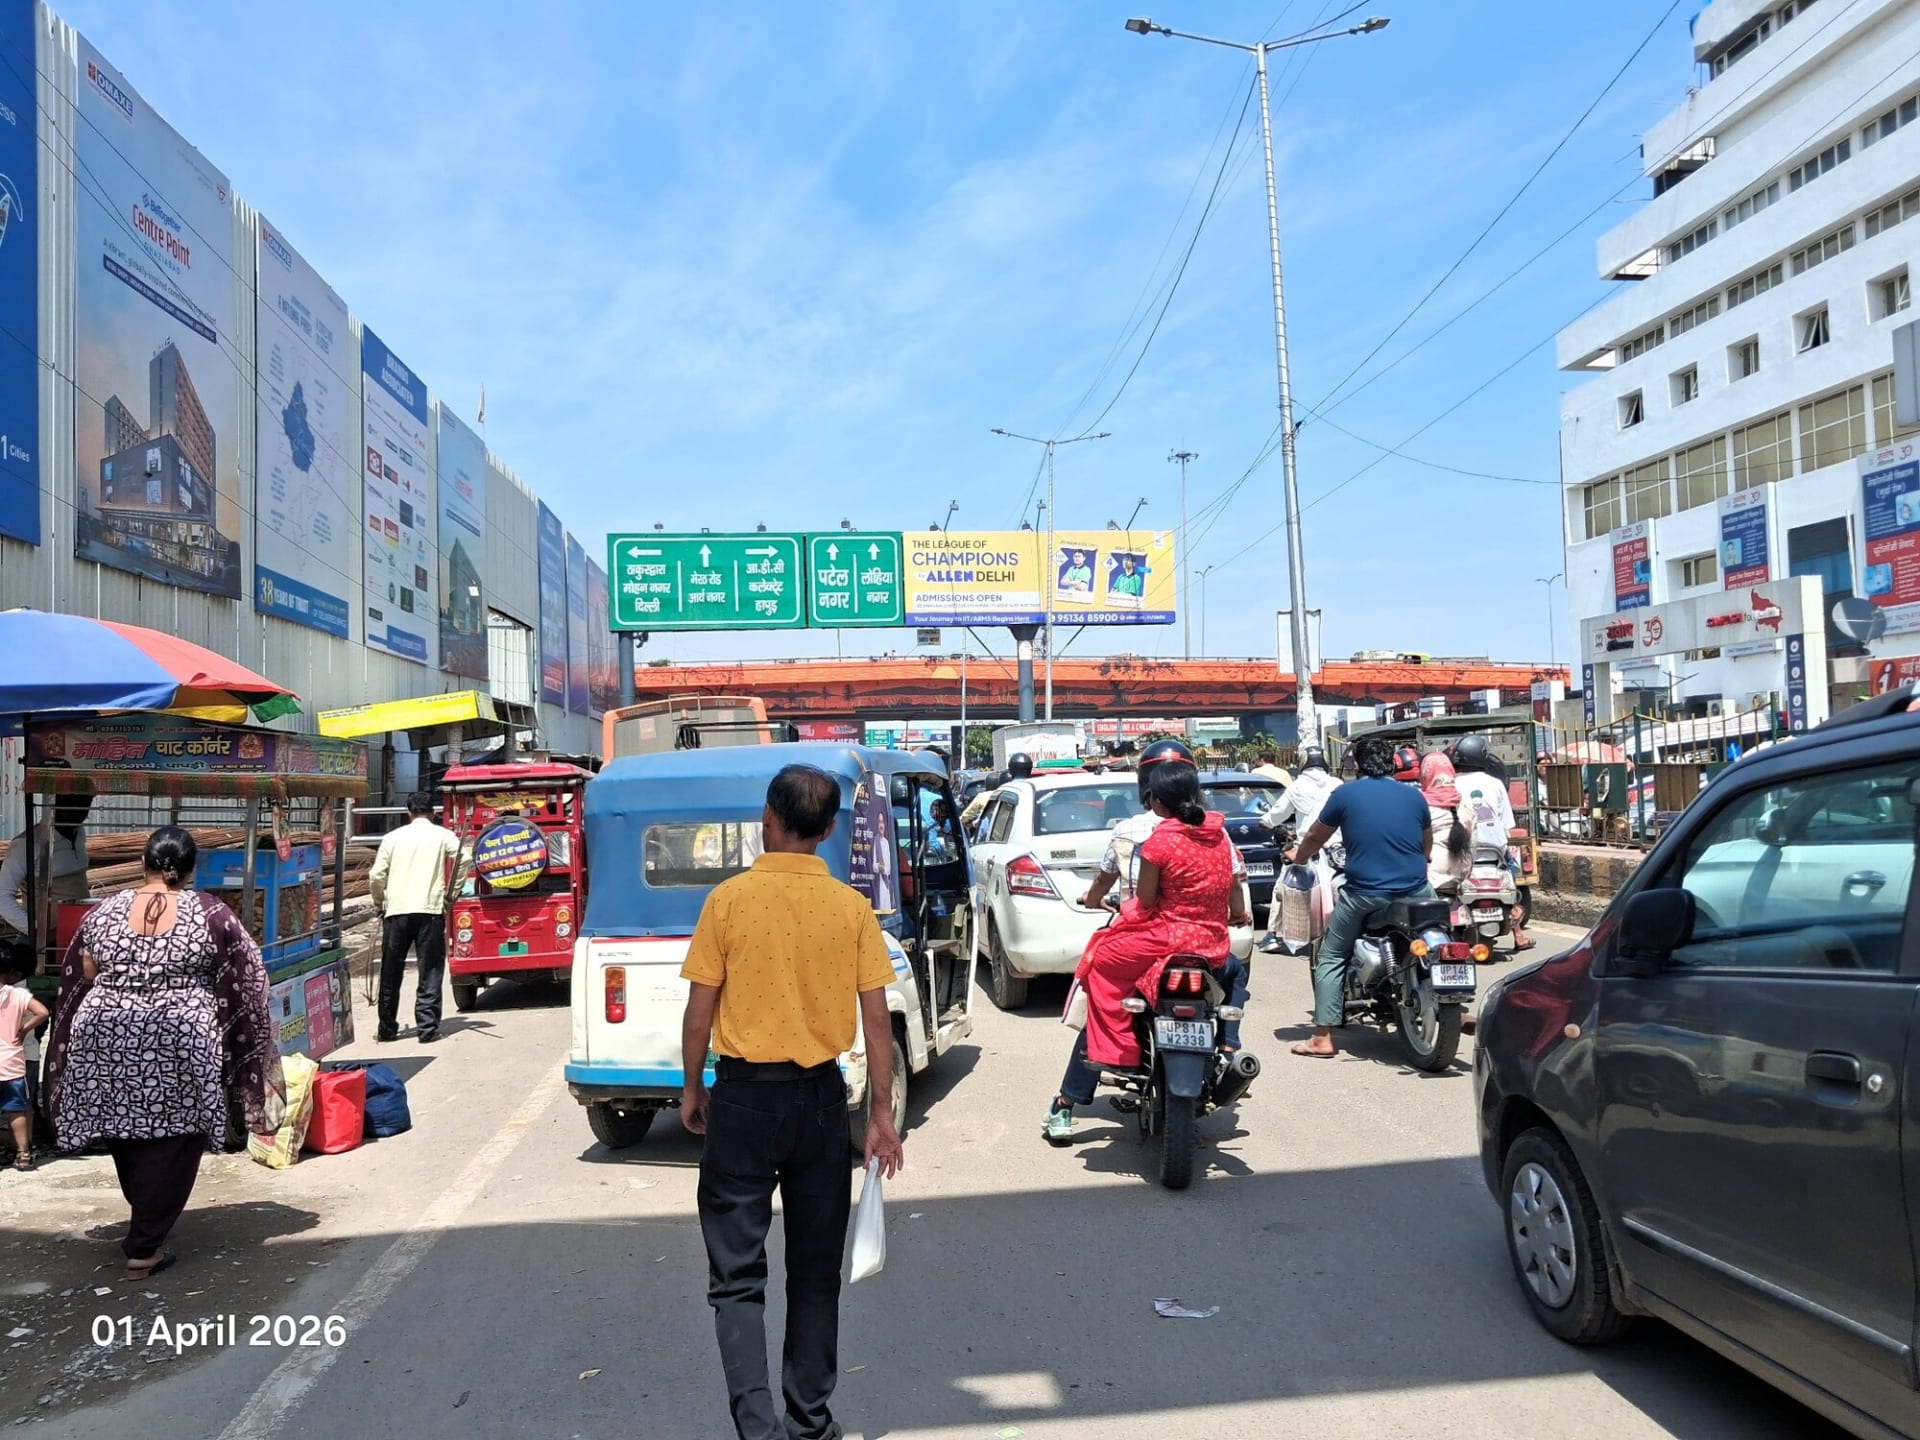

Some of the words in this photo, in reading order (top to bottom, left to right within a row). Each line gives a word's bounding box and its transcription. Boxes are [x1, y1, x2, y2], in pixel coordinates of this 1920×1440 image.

[97, 69, 133, 117] OMAXE
[132, 203, 164, 248] Centre
[166, 230, 191, 269] Point
[10, 444, 30, 464] Cities
[912, 540, 930, 548] THE
[932, 540, 971, 549] LEAGUE
[973, 540, 987, 548] OF
[912, 552, 1018, 566] CHAMPIONS
[690, 570, 708, 585] मेरठ
[709, 570, 722, 585] रोड
[817, 563, 850, 587] पटेल
[860, 566, 893, 585] लोहिया
[926, 570, 974, 582] ALLEN
[976, 571, 1015, 582] DELHI
[261, 576, 274, 608] 38
[623, 579, 648, 594] मोहन
[649, 582, 671, 593] नगर
[688, 588, 706, 604] आर्य
[706, 591, 726, 602] नगर
[818, 591, 850, 608] नगर
[865, 591, 889, 604] नगर
[916, 594, 975, 602] ADMISSIONS
[976, 594, 1002, 602] OPEN
[635, 597, 660, 613] दिल्ली
[929, 616, 954, 624] Journey
[992, 615, 1014, 624] Begins
[1057, 613, 1085, 622] 95136
[1087, 612, 1118, 622] 85900
[1642, 618, 1663, 647] 30
[155, 739, 185, 756] चाट
[187, 734, 231, 757] कॉर्नर
[1166, 1022, 1206, 1035] UP81A
[1166, 1033, 1206, 1047] W2338
